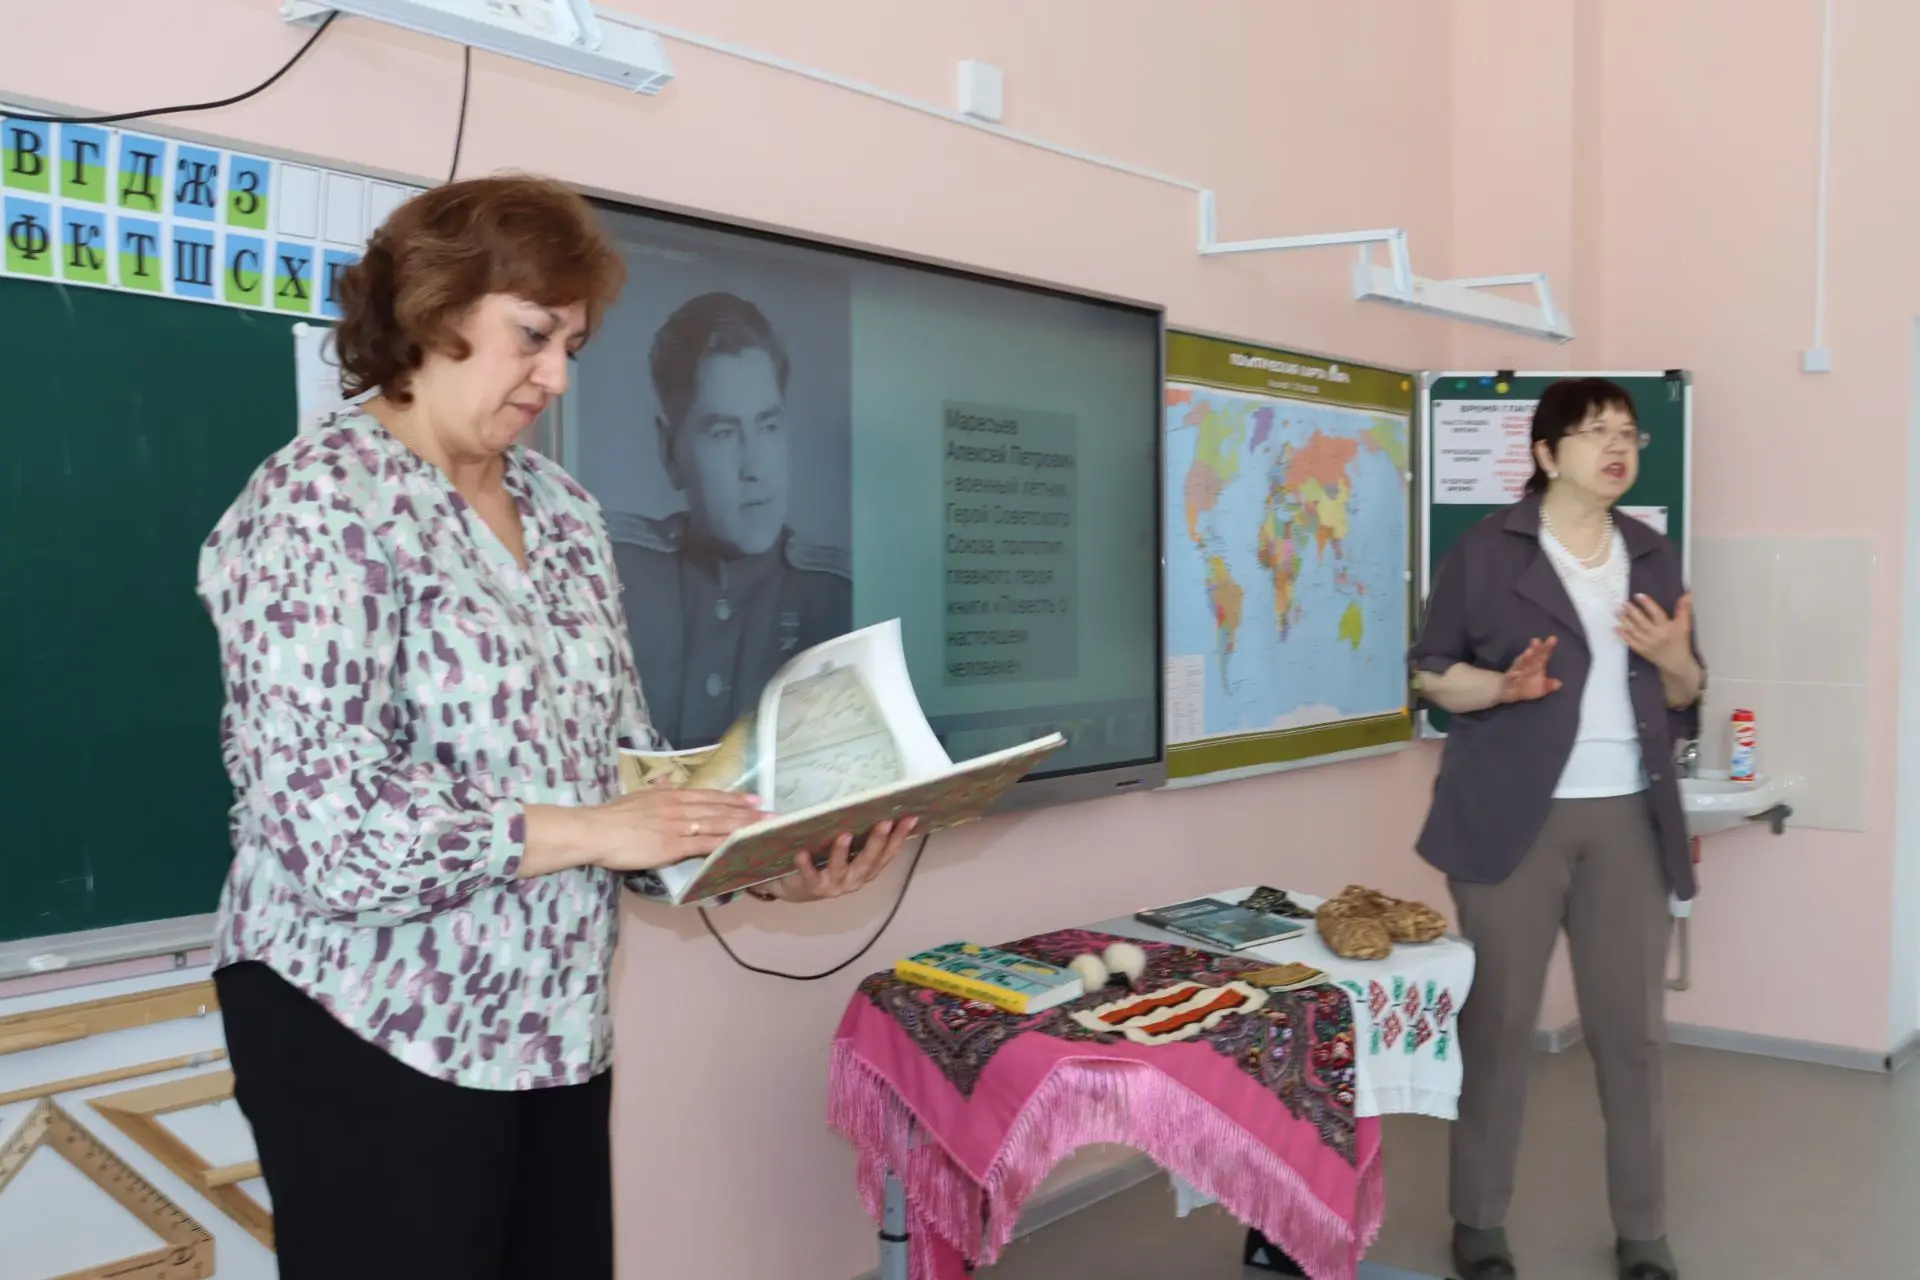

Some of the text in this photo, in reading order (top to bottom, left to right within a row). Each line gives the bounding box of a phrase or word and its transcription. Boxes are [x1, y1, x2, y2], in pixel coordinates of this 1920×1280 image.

[10, 127, 43, 176] В
[70, 139, 99, 186] Г
[122, 150, 159, 211] Д
[175, 157, 217, 209] Ж
[8, 213, 50, 261] Ф
[68, 221, 102, 271] К
[126, 231, 157, 277] Т
[173, 239, 214, 287] Ш
[232, 248, 260, 293] С
[278, 255, 310, 300] Х
